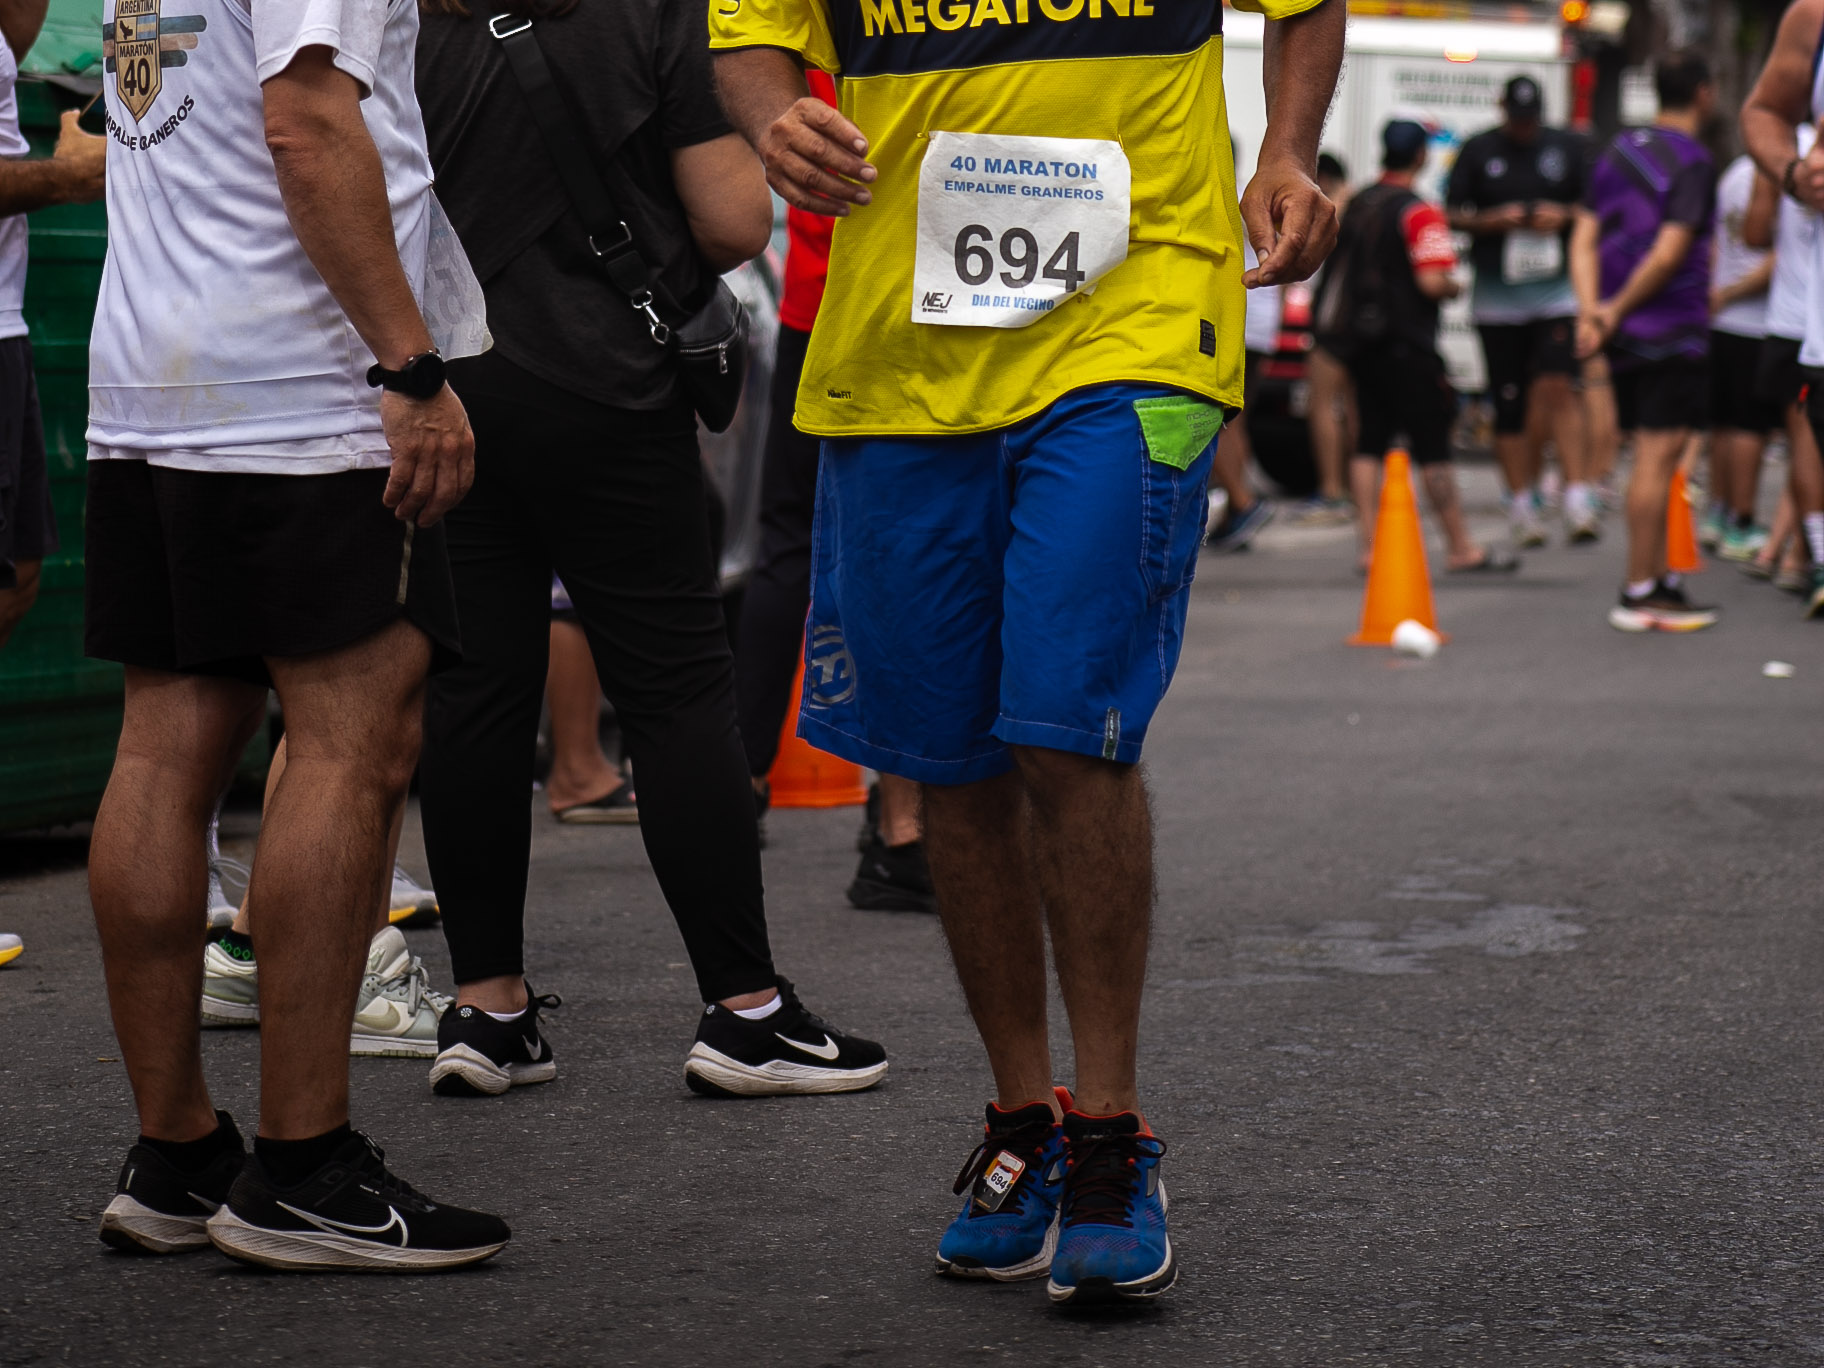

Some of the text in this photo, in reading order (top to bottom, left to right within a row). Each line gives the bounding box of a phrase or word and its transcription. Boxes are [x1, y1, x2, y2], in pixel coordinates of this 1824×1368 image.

[119, 41, 154, 58] MARATÓN
[123, 58, 151, 97] 40
[950, 155, 1098, 179] 40 MARATON
[944, 180, 1104, 201] EMPALME GRANEROS
[954, 223, 1085, 293] 694
[921, 291, 953, 309] NEJ
[972, 293, 1055, 311] DIA DEL VECINO
[991, 1172, 1008, 1190] 694
